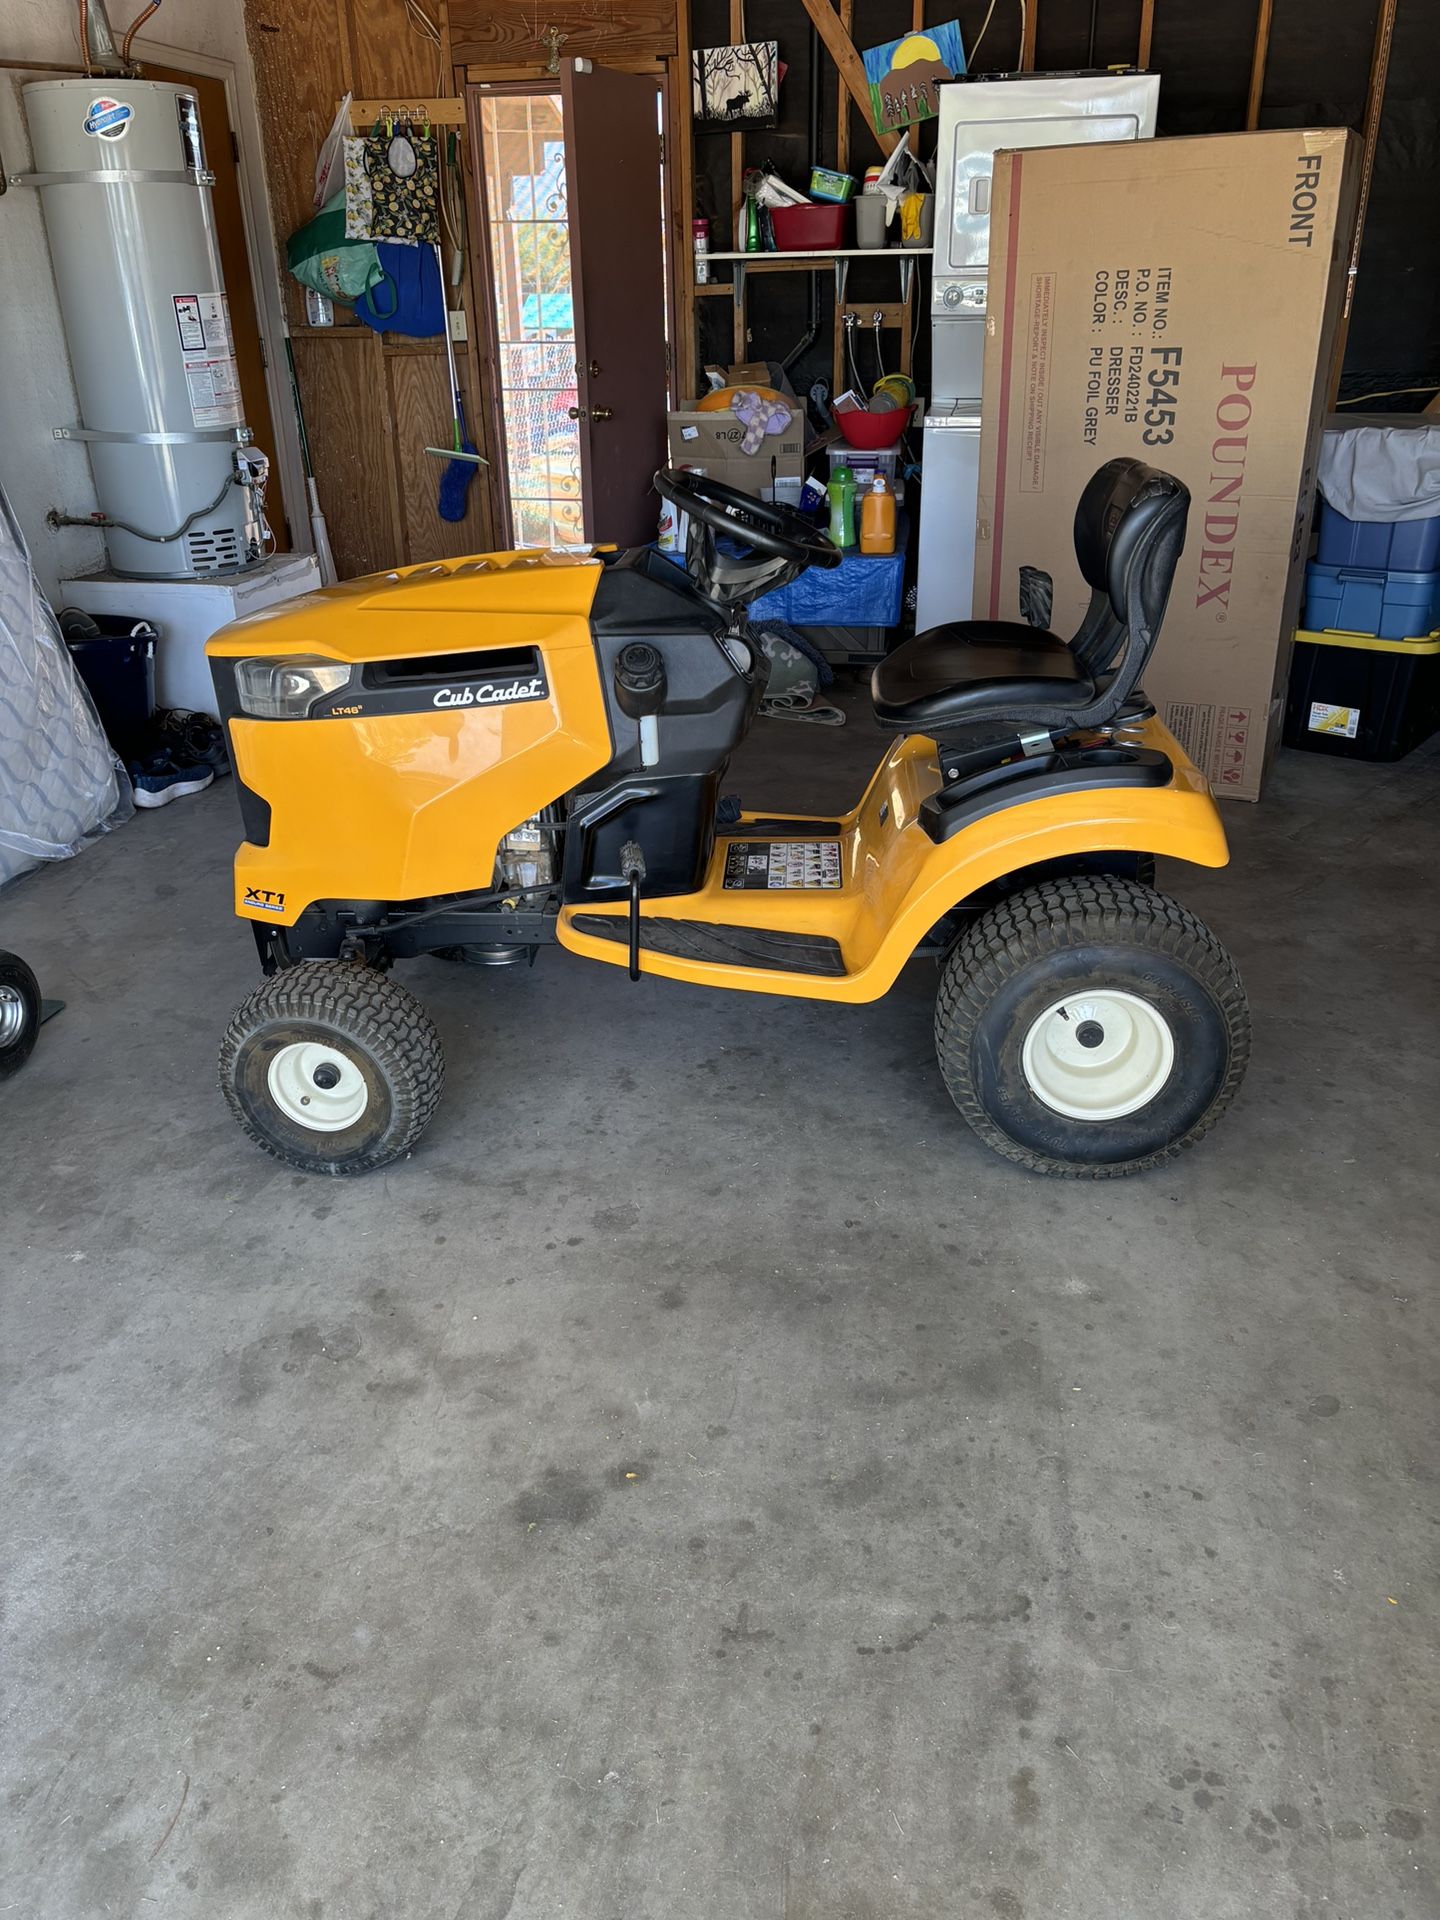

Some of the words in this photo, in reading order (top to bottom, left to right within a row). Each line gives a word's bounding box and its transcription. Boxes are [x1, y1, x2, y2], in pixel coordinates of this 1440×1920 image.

[1287, 155, 1321, 248] FRONT
[1093, 271, 1109, 324] COLOR
[1114, 270, 1129, 315] DESC.
[1135, 269, 1151, 297] P.O.
[1156, 268, 1172, 303] ITEM
[1042, 277, 1051, 327] IMMEDIATELY
[1133, 301, 1147, 327] NO.
[1152, 308, 1167, 339] NO.:
[1040, 329, 1048, 361] INSPECT
[1089, 347, 1102, 366] PU
[1029, 383, 1036, 394] ON
[1087, 372, 1101, 403] FOIL
[1105, 347, 1123, 415] DRESSER
[1125, 347, 1143, 423] FD240221B
[1142, 347, 1182, 446] F5453
[1084, 407, 1098, 446] GREY
[1196, 361, 1258, 610] POUNDEX
[433, 688, 474, 707] Cub
[475, 679, 543, 703] Cadet
[1215, 731, 1223, 752] HANDLE
[245, 887, 285, 905] XT1
